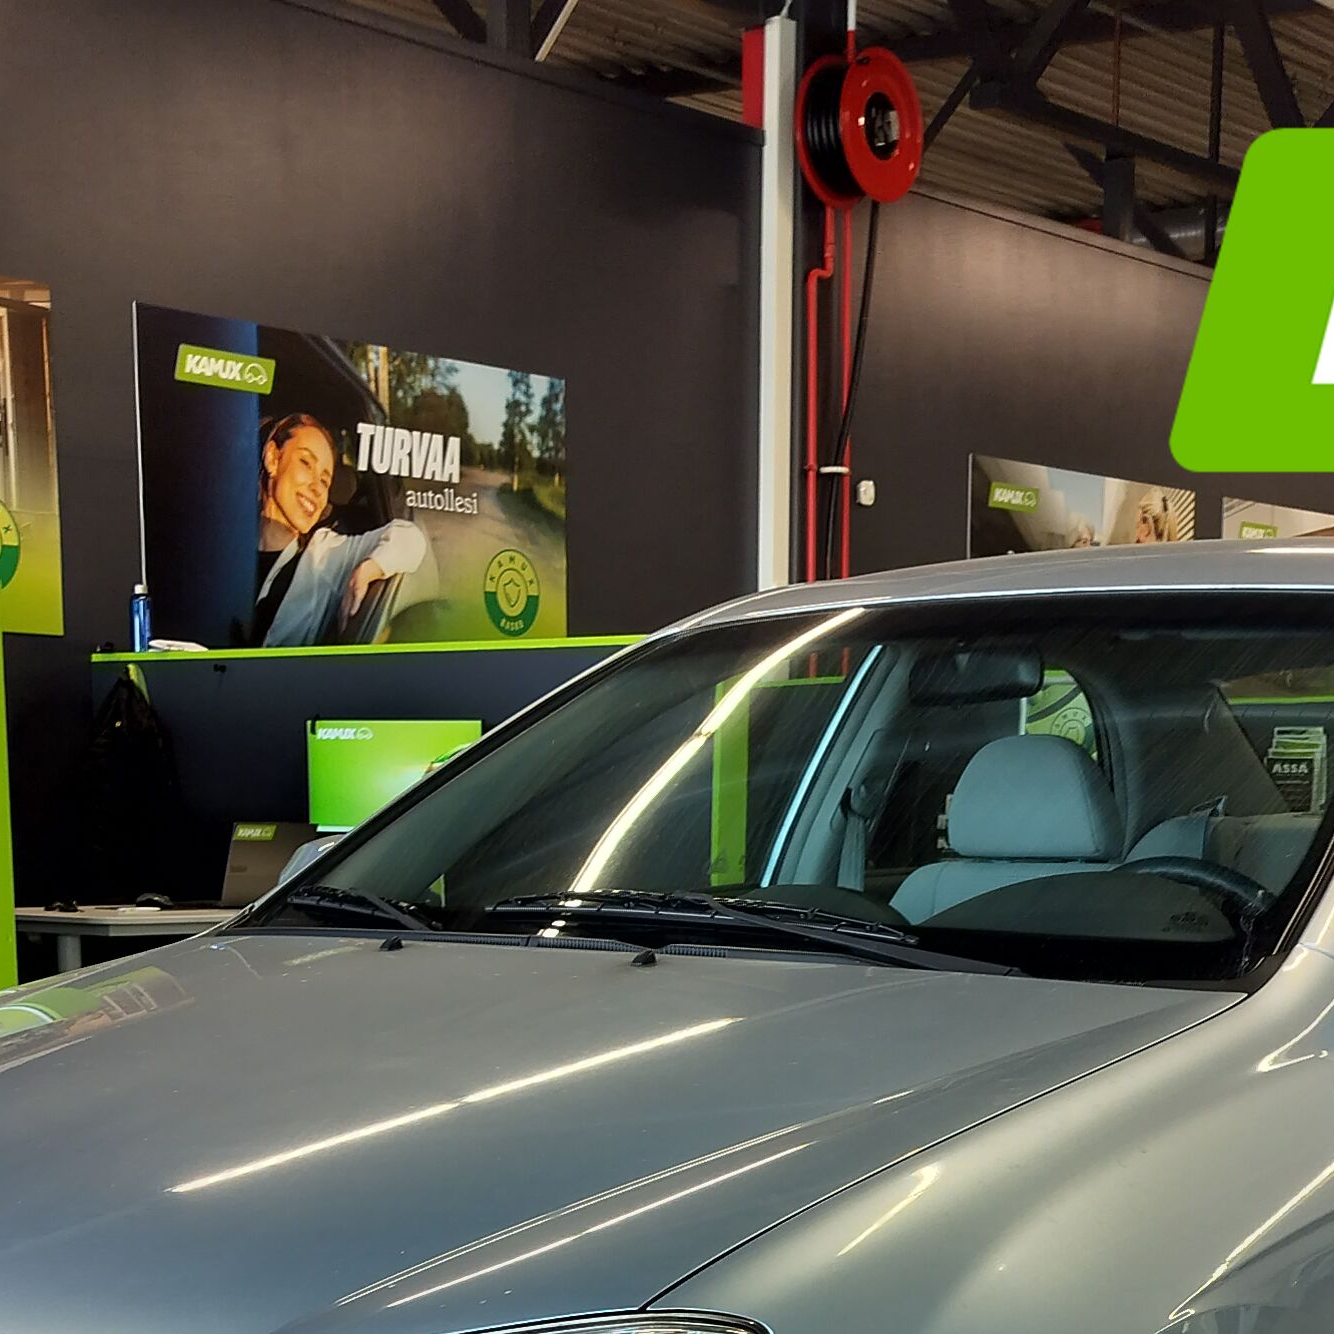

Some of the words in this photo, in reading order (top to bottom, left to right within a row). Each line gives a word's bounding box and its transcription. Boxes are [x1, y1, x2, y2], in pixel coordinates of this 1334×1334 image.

[185, 354, 244, 381] KAMUX
[357, 422, 461, 484] TURVAA
[405, 488, 479, 515] autollesi
